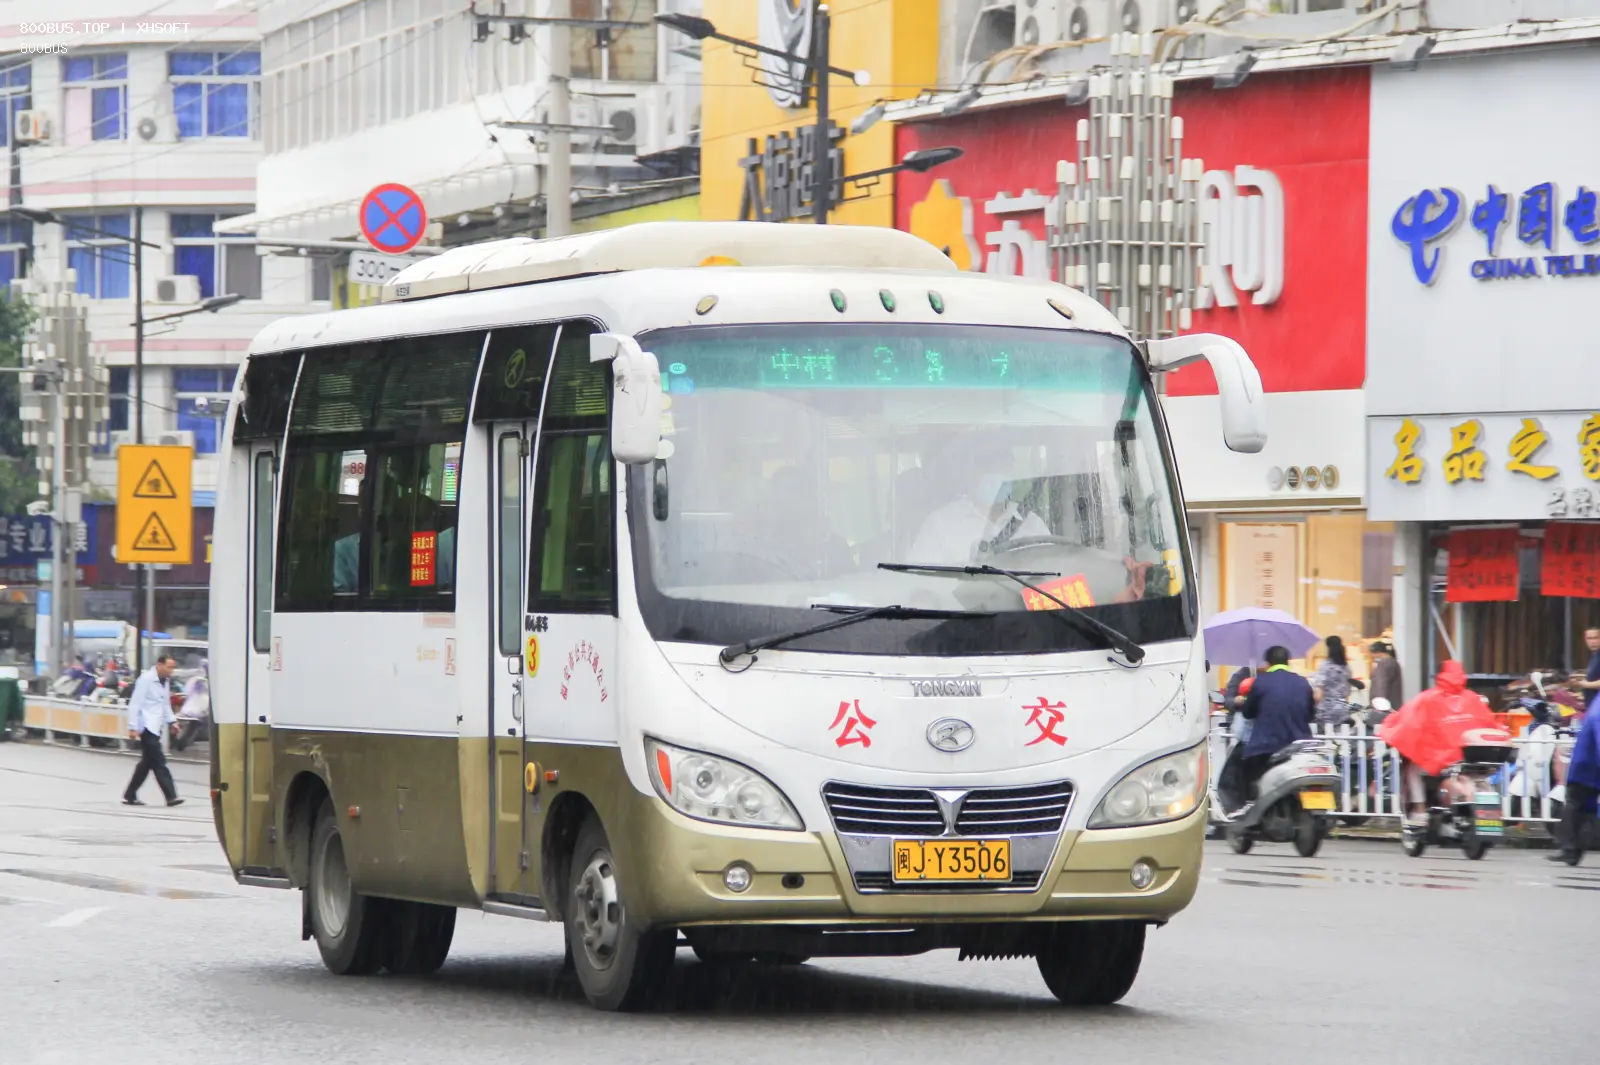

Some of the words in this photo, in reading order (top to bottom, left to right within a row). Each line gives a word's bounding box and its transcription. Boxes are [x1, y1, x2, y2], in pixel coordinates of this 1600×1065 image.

[1470, 257, 1539, 279] CHINA
[528, 637, 537, 672] 3
[911, 679, 982, 698] TONGXIN
[828, 699, 877, 748] 公
[1021, 696, 1068, 747] 交
